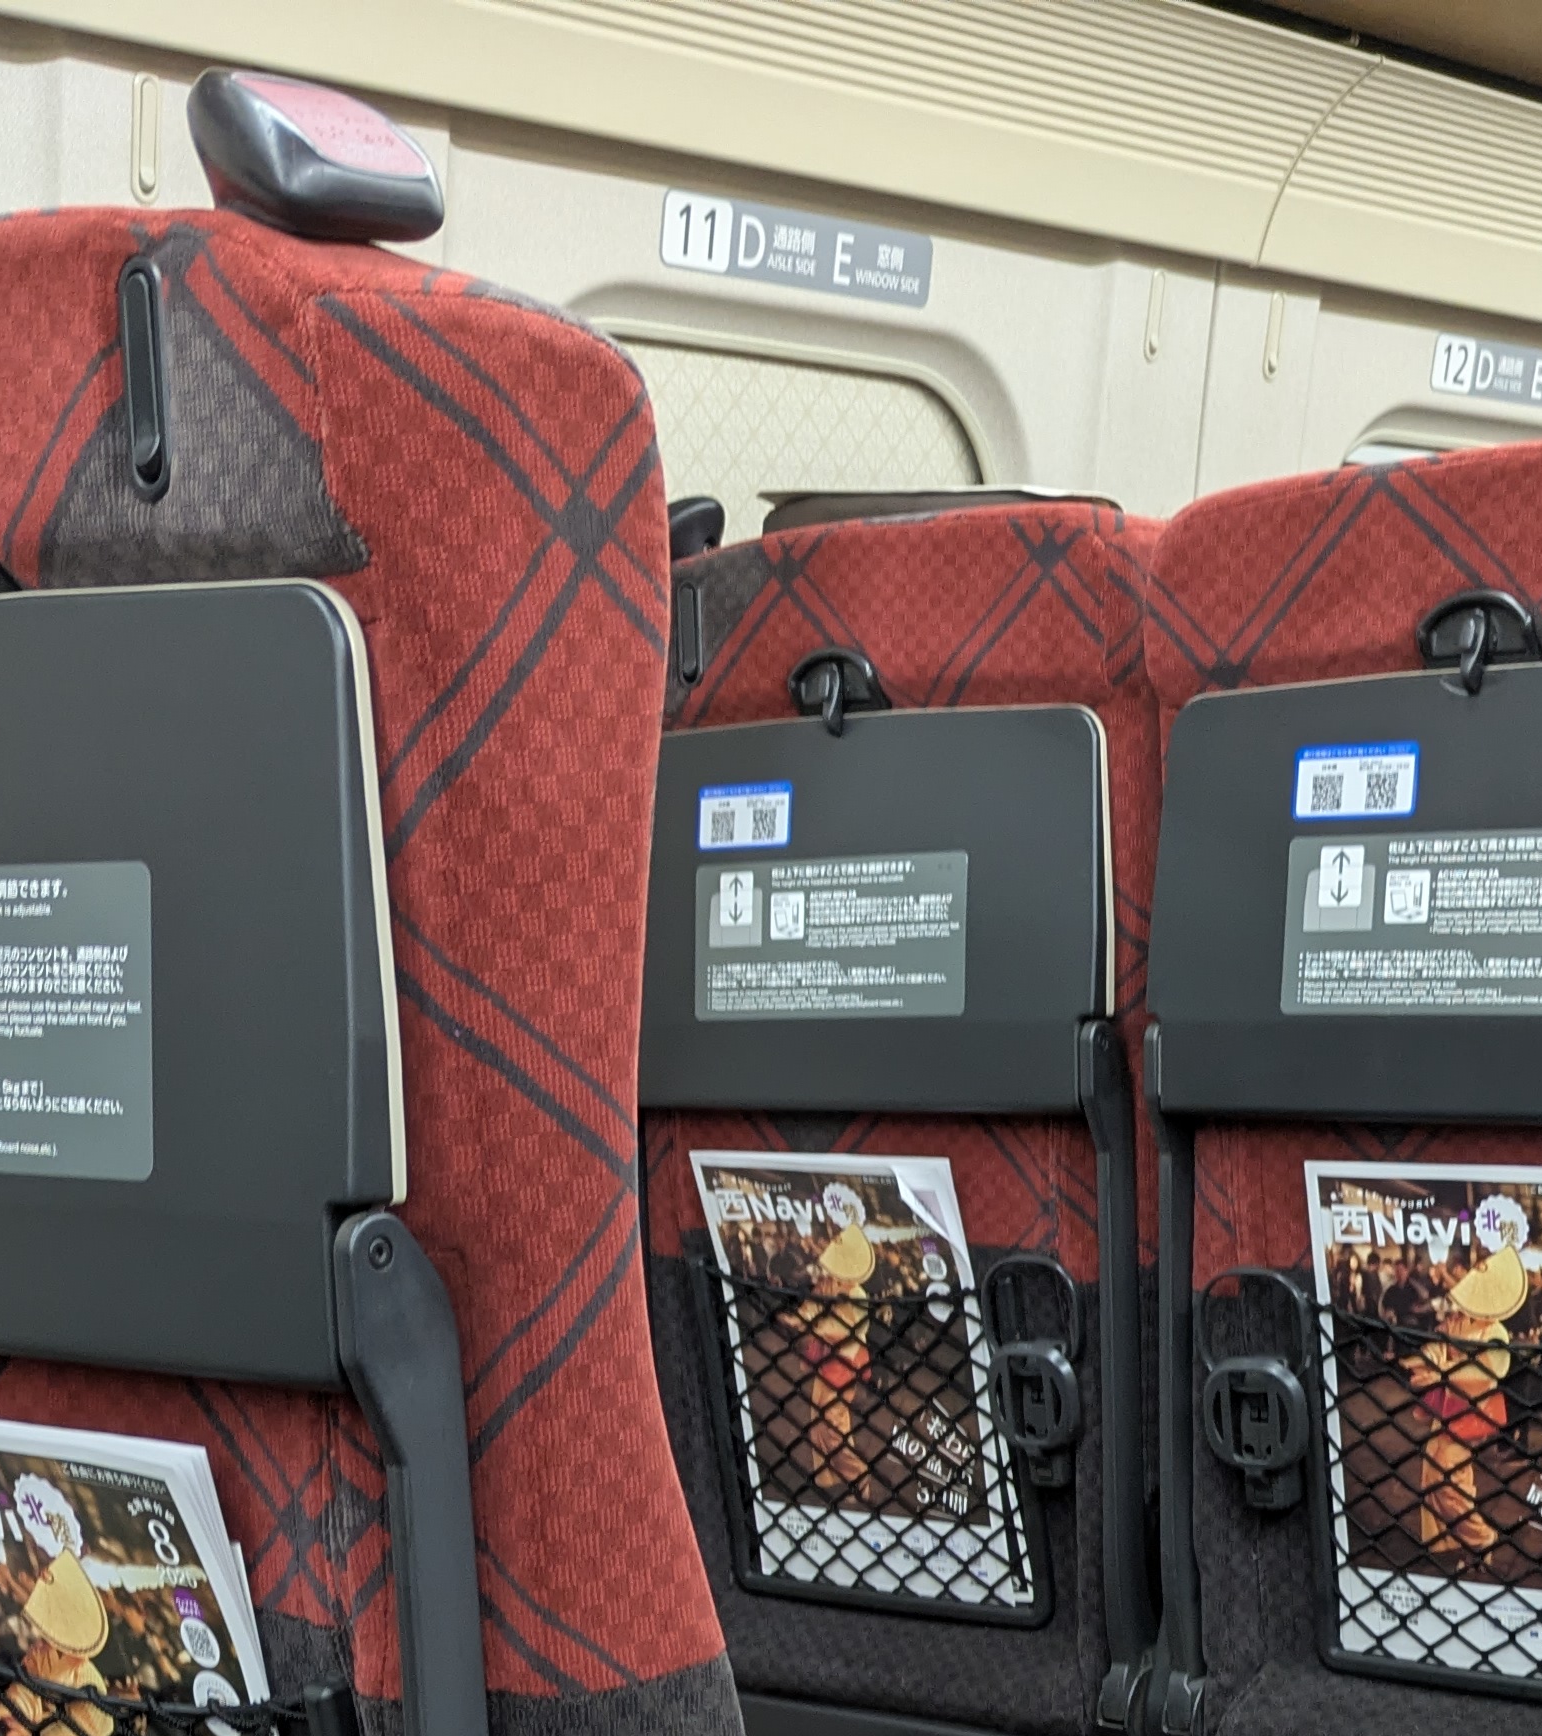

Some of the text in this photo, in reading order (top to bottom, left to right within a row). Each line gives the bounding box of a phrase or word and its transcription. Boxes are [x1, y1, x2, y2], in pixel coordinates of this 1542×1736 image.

[679, 203, 717, 262] 11
[737, 213, 766, 269] D
[832, 231, 855, 287] E
[855, 268, 921, 295] WINDOW SIDE
[1443, 342, 1469, 386] 12
[1475, 349, 1495, 391] D
[715, 1187, 826, 1223] 西Navi
[1331, 1202, 1471, 1248] 西Navi
[148, 1518, 180, 1567] 8
